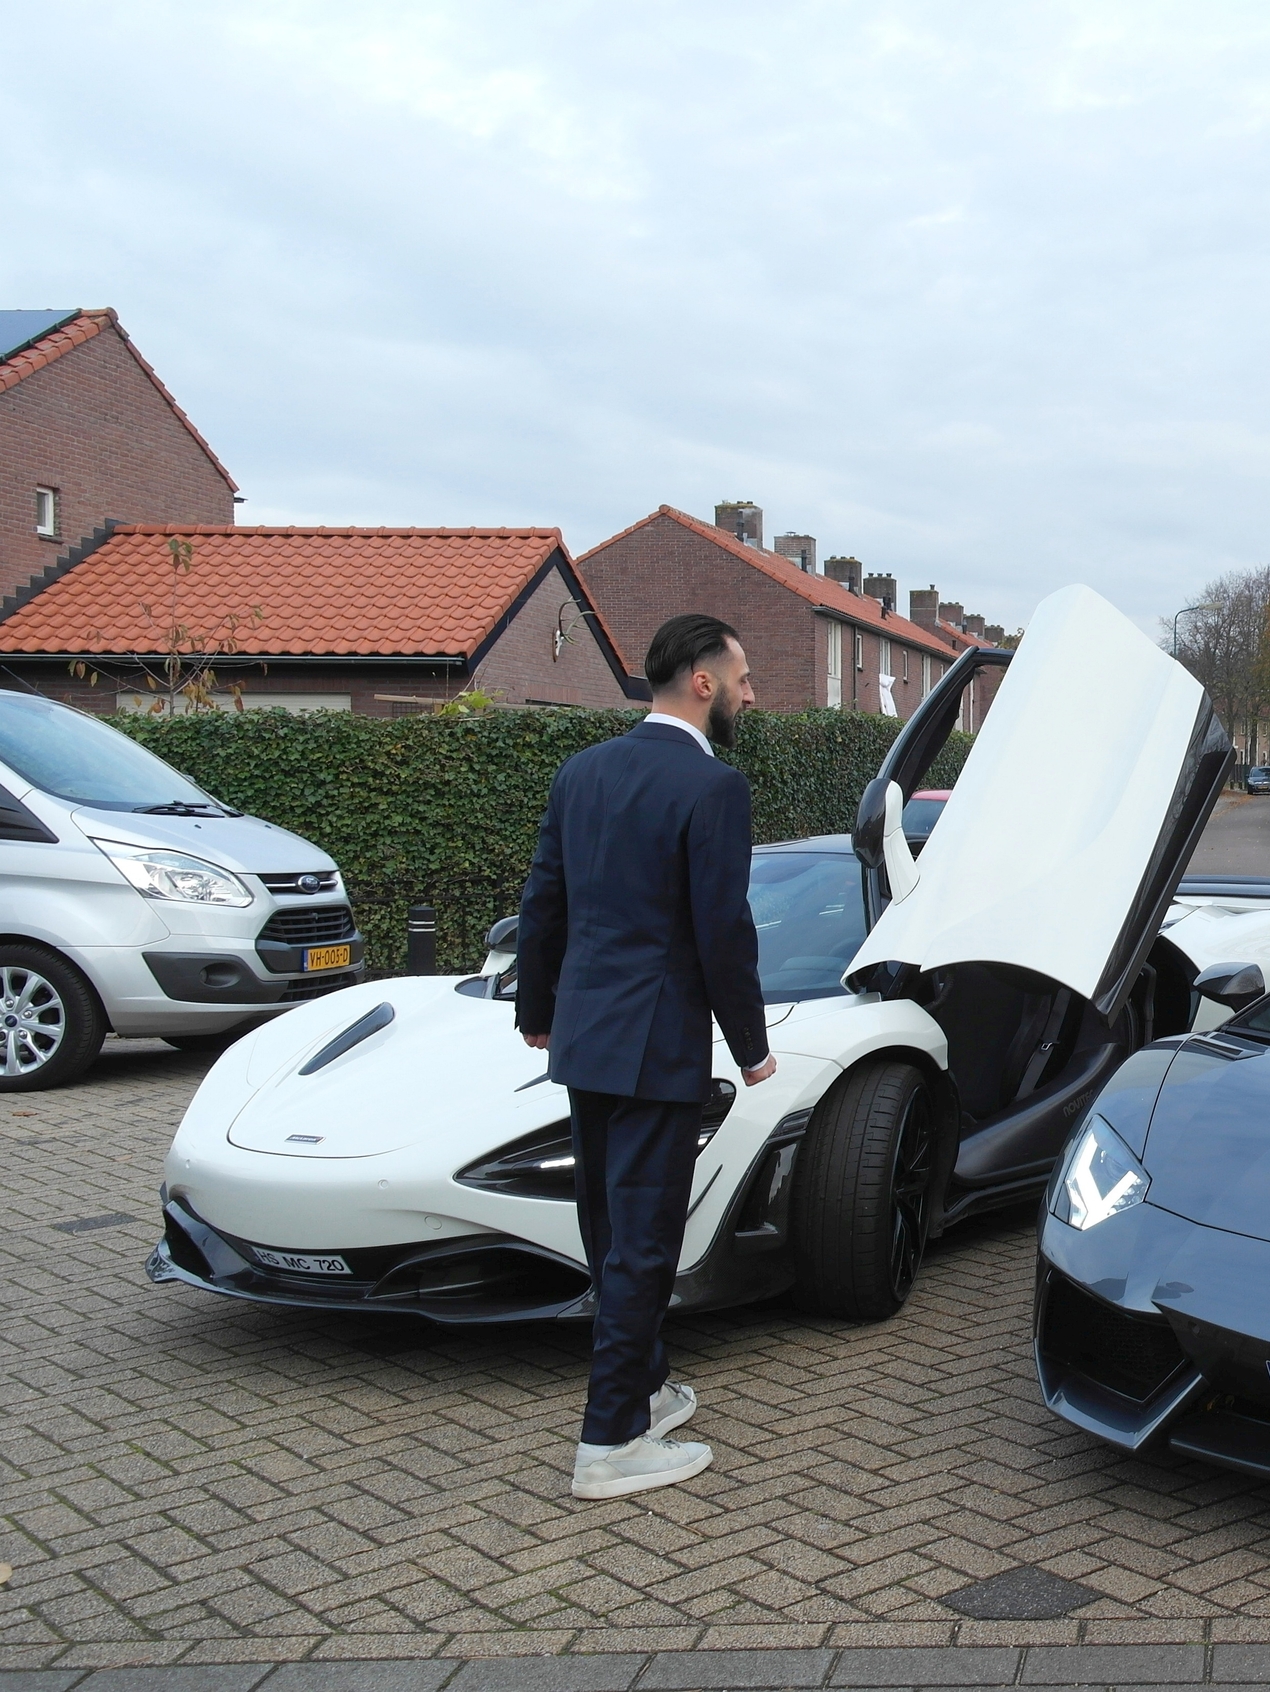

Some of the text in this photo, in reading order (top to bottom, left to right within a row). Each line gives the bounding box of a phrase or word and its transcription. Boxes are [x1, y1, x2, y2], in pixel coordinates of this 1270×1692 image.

[310, 948, 348, 966] VH-005-D
[256, 1250, 344, 1271] HS MC 720
